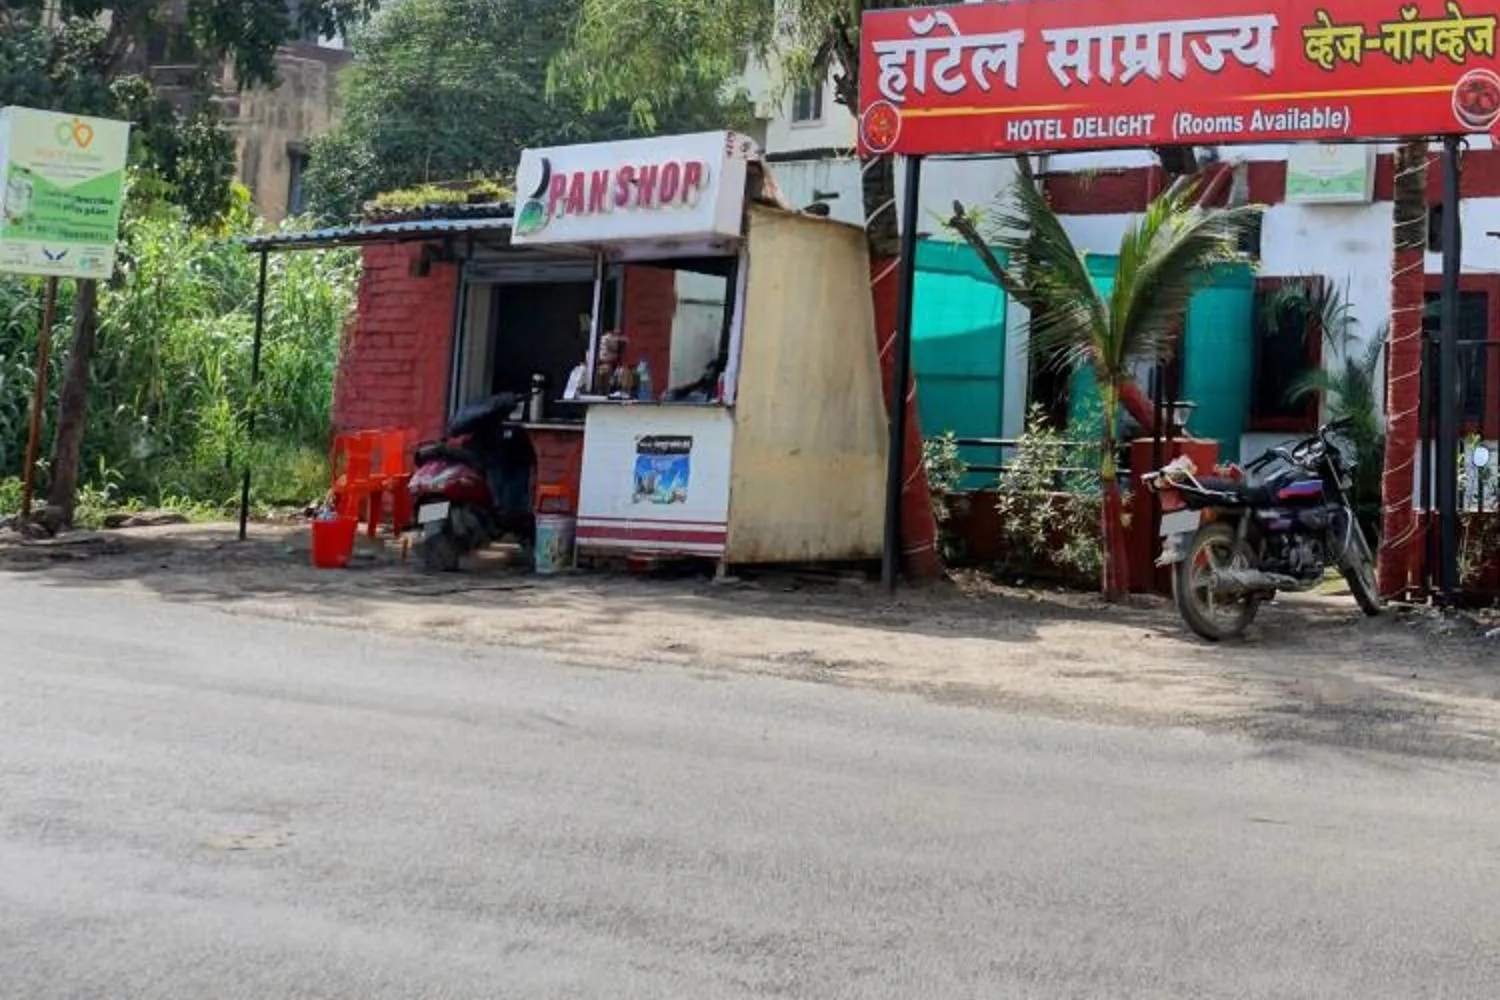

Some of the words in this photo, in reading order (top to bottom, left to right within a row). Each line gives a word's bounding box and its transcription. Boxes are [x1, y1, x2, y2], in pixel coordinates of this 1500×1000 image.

[871, 11, 1025, 102] हॉटेल
[1040, 13, 1279, 87] साम्राज्य
[1007, 119, 1066, 141] HOTEL
[1073, 114, 1154, 139] DELIGHT
[1172, 111, 1244, 140] (Rooms
[1250, 106, 1350, 134] Available)
[547, 171, 609, 216] PAN
[615, 161, 702, 207] SHOP
